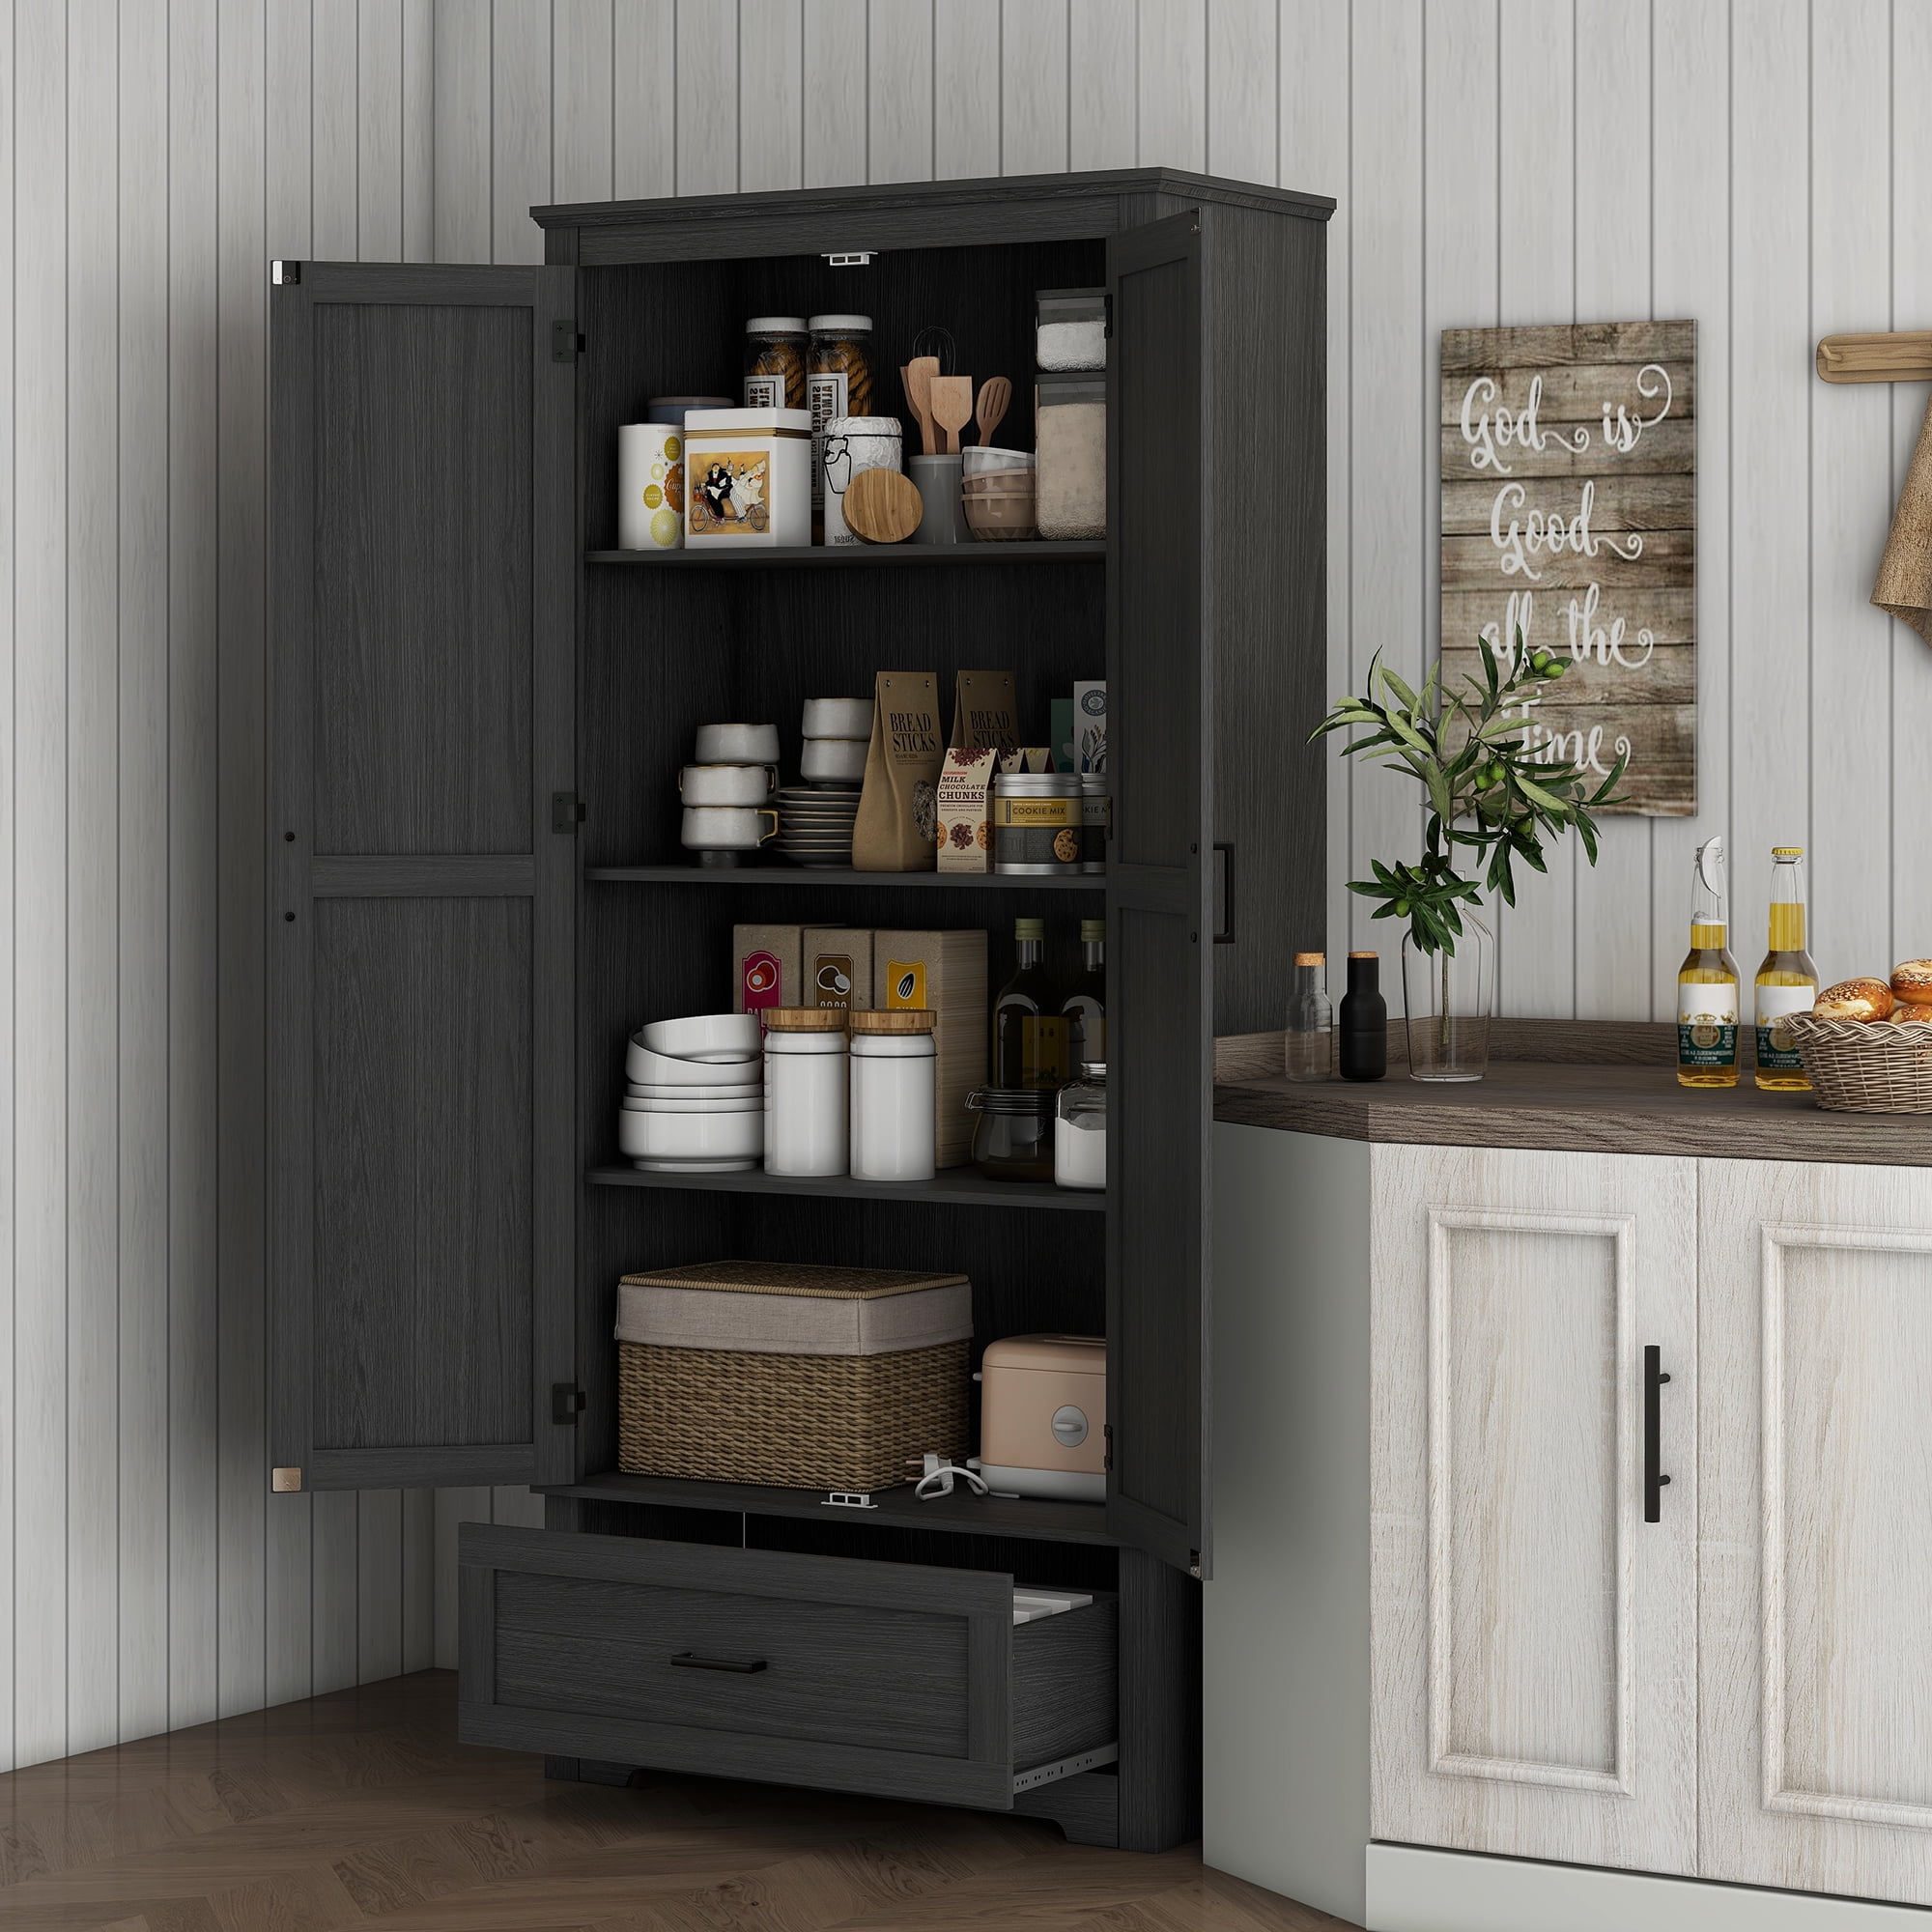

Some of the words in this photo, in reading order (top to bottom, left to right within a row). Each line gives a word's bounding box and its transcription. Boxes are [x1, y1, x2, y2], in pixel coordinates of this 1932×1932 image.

[1460, 374, 1590, 473] God
[1602, 364, 1673, 454] is
[1490, 480, 1643, 581] Good
[1557, 582, 1654, 668] the
[890, 713, 931, 731] BREAD
[970, 711, 1009, 729] BREAD
[893, 732, 936, 752] STICKS
[939, 791, 984, 800] CHUNKS
